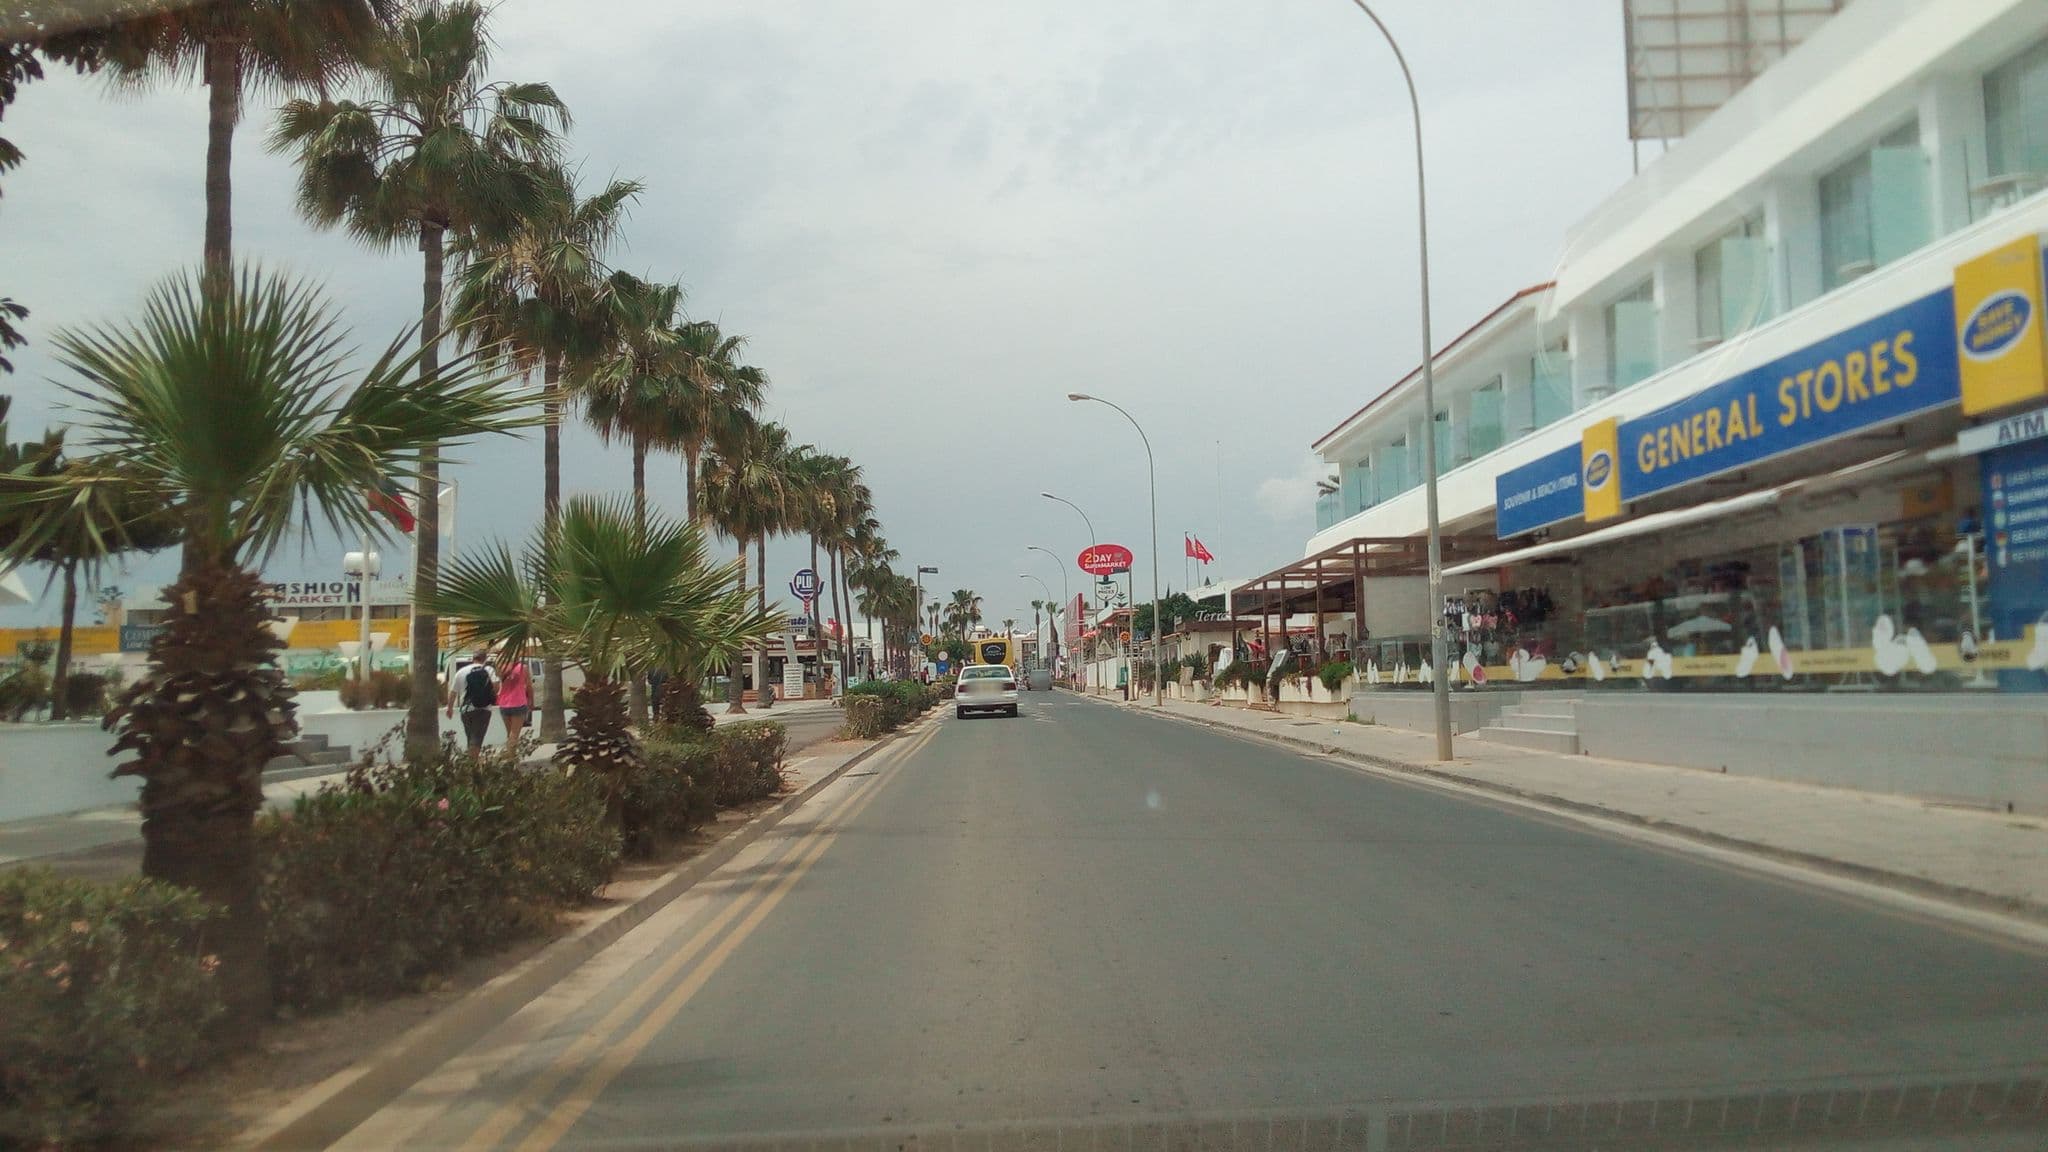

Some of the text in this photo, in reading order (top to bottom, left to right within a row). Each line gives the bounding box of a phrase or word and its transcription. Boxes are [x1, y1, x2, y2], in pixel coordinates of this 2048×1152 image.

[1637, 330, 1917, 473] GENERAL STORES
[1998, 414, 2045, 441] ATM
